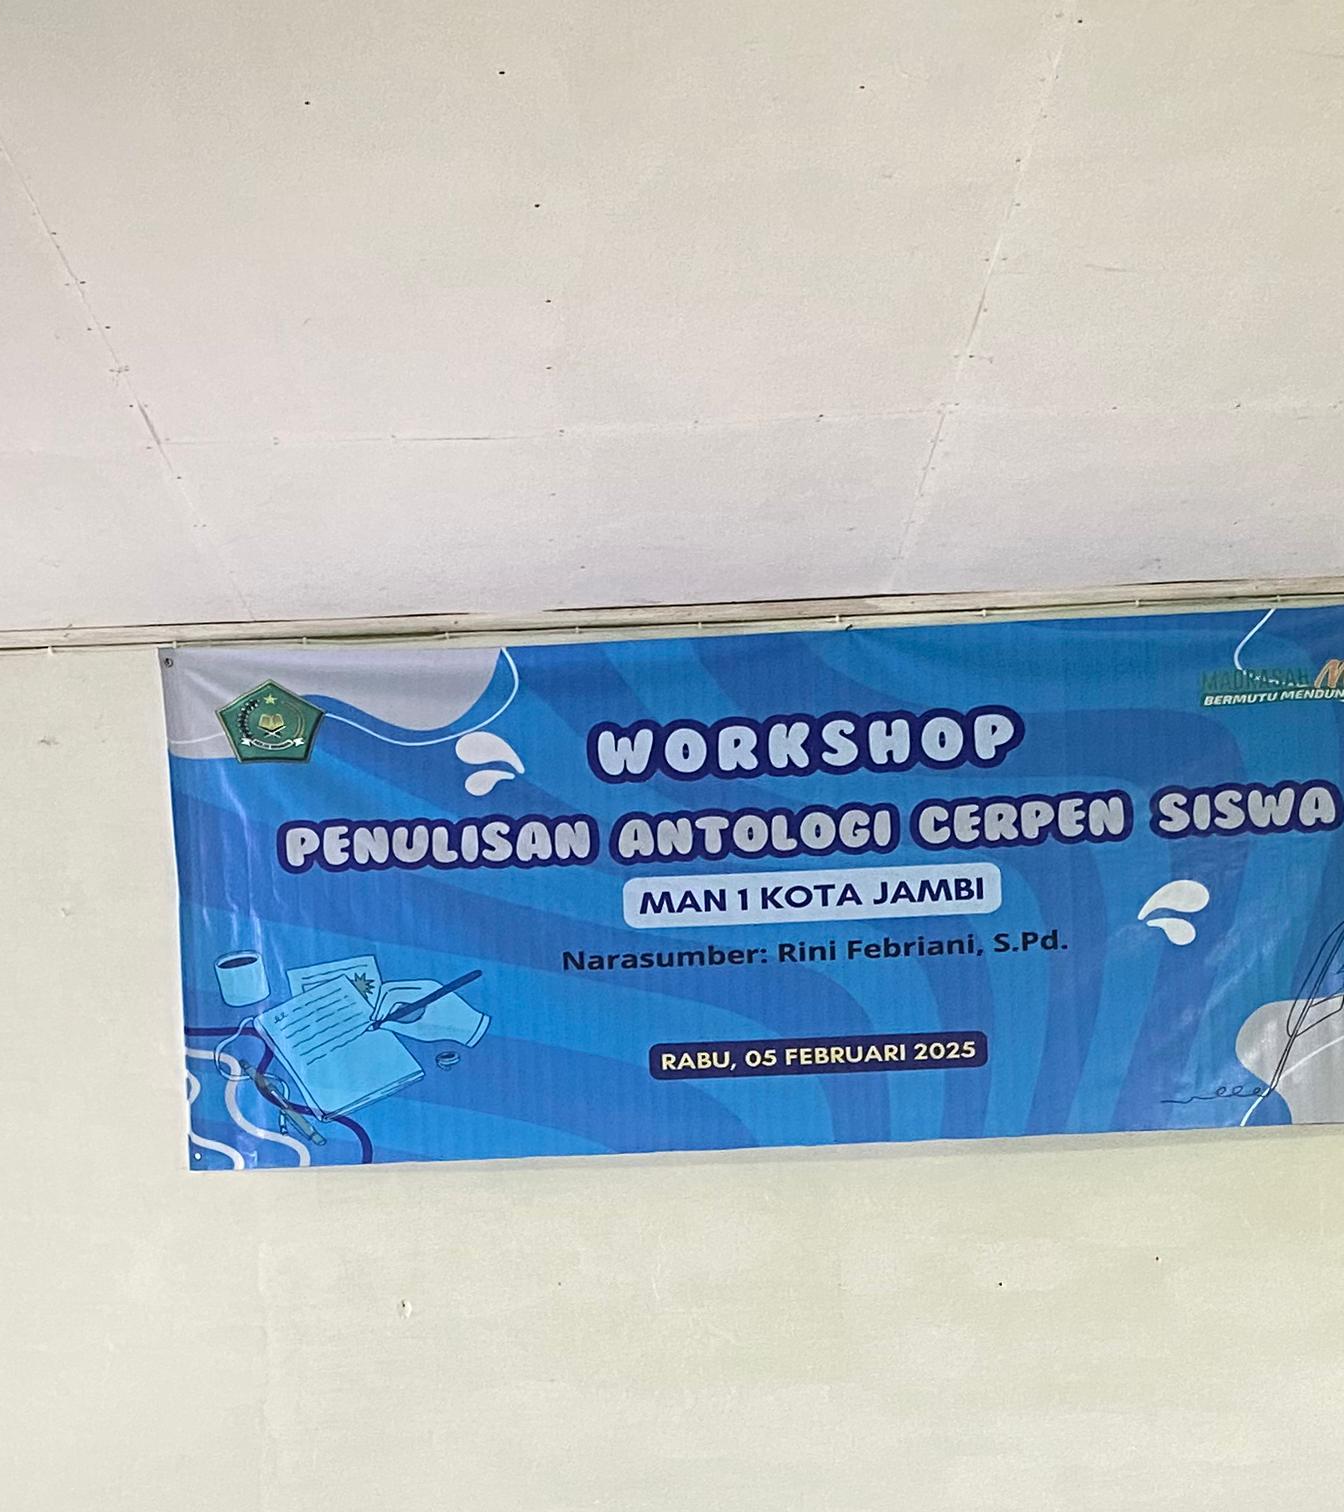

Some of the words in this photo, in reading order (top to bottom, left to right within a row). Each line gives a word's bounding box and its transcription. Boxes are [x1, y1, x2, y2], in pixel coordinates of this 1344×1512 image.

[1203, 692, 1278, 706] BERMUTU
[596, 713, 1015, 777] WORKSHOP
[285, 820, 592, 868] PENULISAN
[617, 809, 892, 859] ANTOLOGI
[918, 796, 1125, 845] CERPEN
[1158, 786, 1337, 832] SISWA
[638, 887, 728, 915] MAN
[737, 887, 749, 911] 1
[761, 883, 864, 910] KOTA
[873, 876, 985, 906] JAMBI
[561, 943, 768, 972] Narasumber:
[778, 937, 837, 964] Rini
[847, 932, 984, 959] Febriani,
[993, 928, 1069, 955] S.Pd.
[661, 1050, 737, 1073] RABU,
[745, 1048, 778, 1068] 05
[785, 1044, 907, 1067] FEBRUARI
[913, 1040, 976, 1062] 2025
